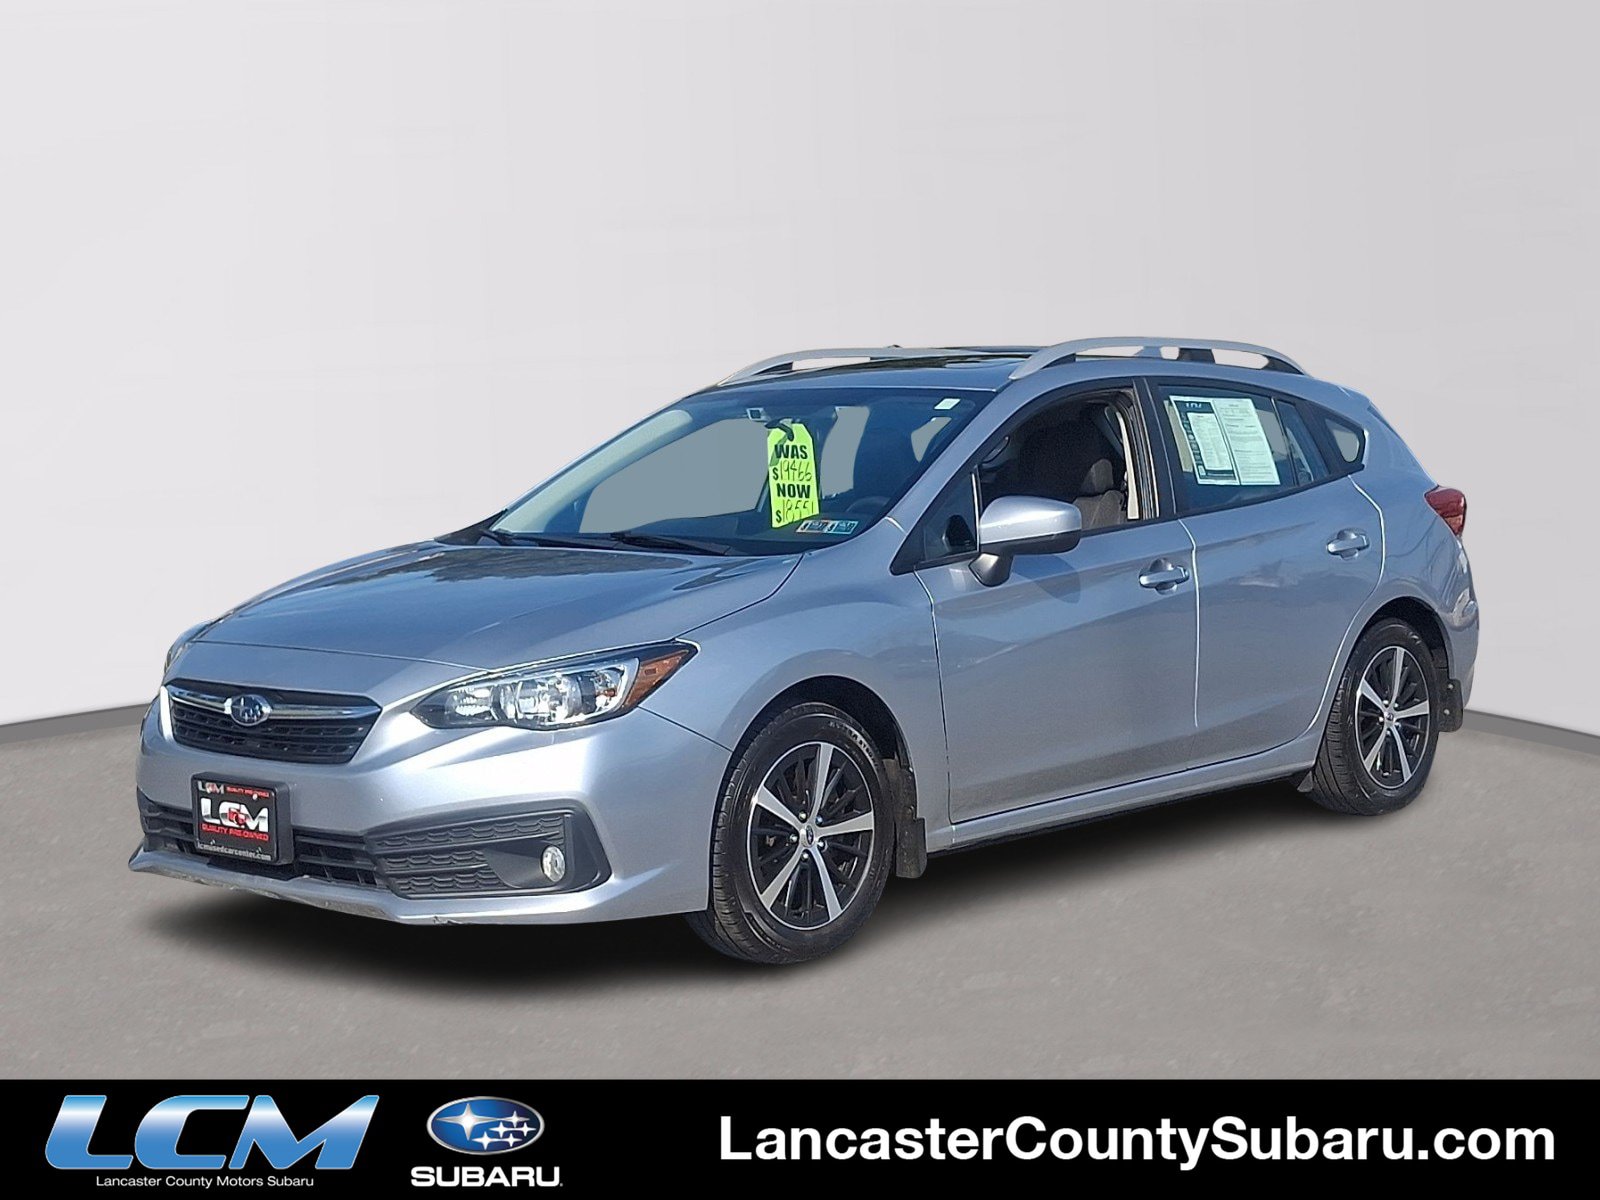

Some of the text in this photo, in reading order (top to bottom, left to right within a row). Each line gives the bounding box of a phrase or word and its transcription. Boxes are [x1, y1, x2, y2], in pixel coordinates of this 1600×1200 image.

[774, 444, 808, 460] WAS
[776, 483, 811, 499] NOW
[201, 798, 268, 832] LCM
[202, 823, 228, 833] QUALITY
